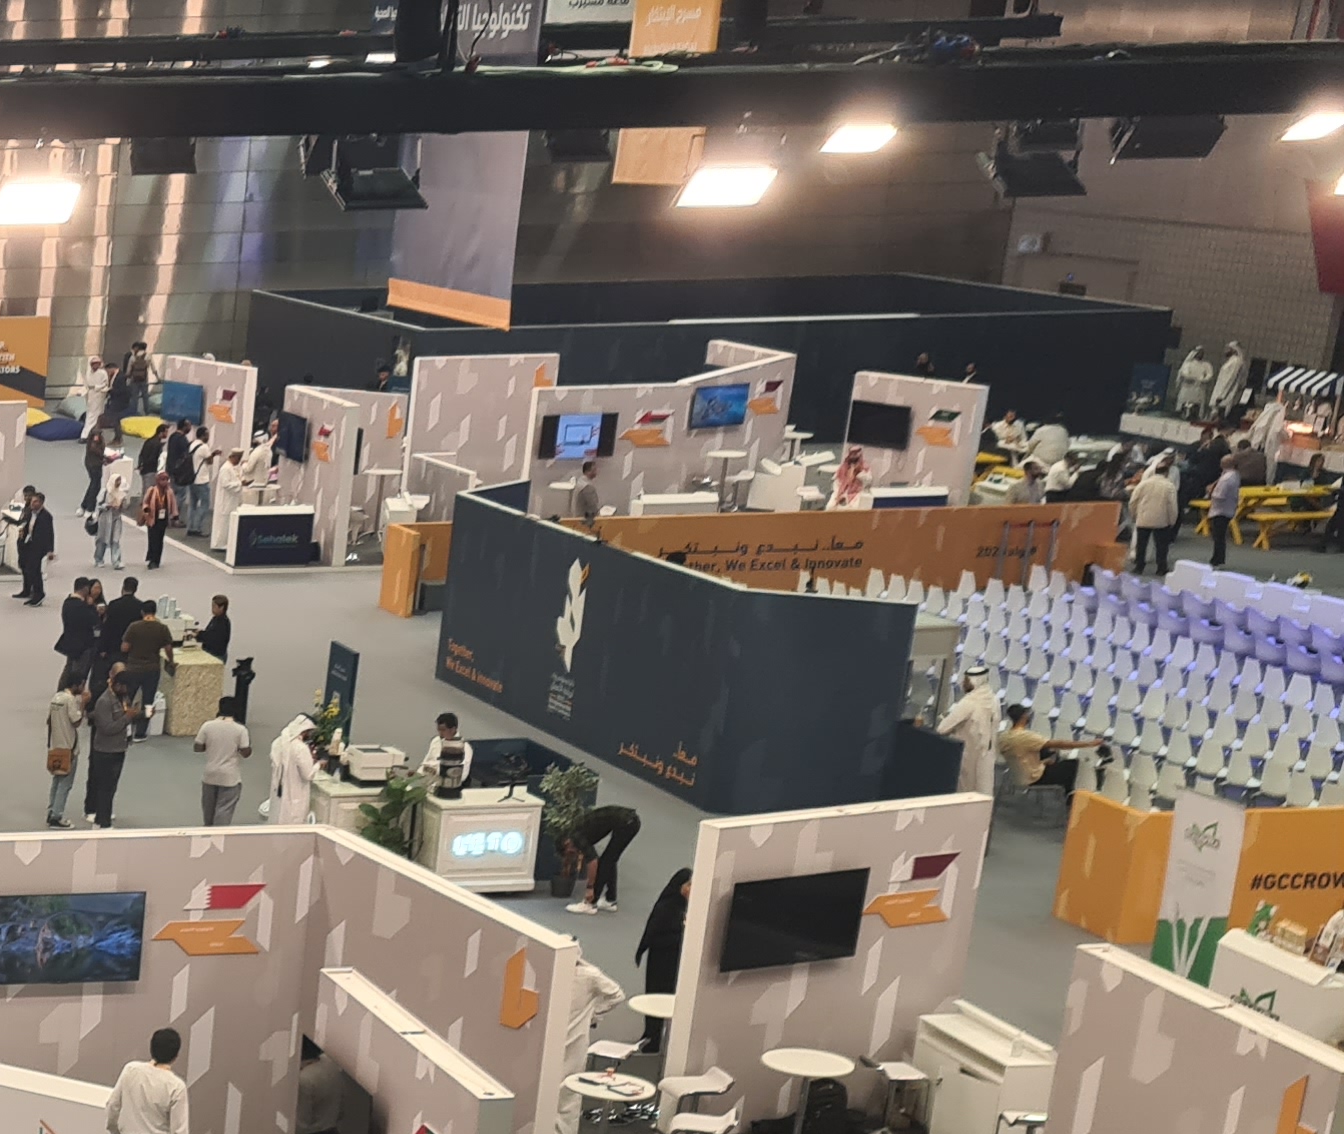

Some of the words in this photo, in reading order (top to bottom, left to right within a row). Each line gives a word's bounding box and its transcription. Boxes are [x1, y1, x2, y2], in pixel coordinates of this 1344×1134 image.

[725, 560, 746, 571] We
[751, 559, 786, 571] Excel
[791, 559, 801, 569] &
